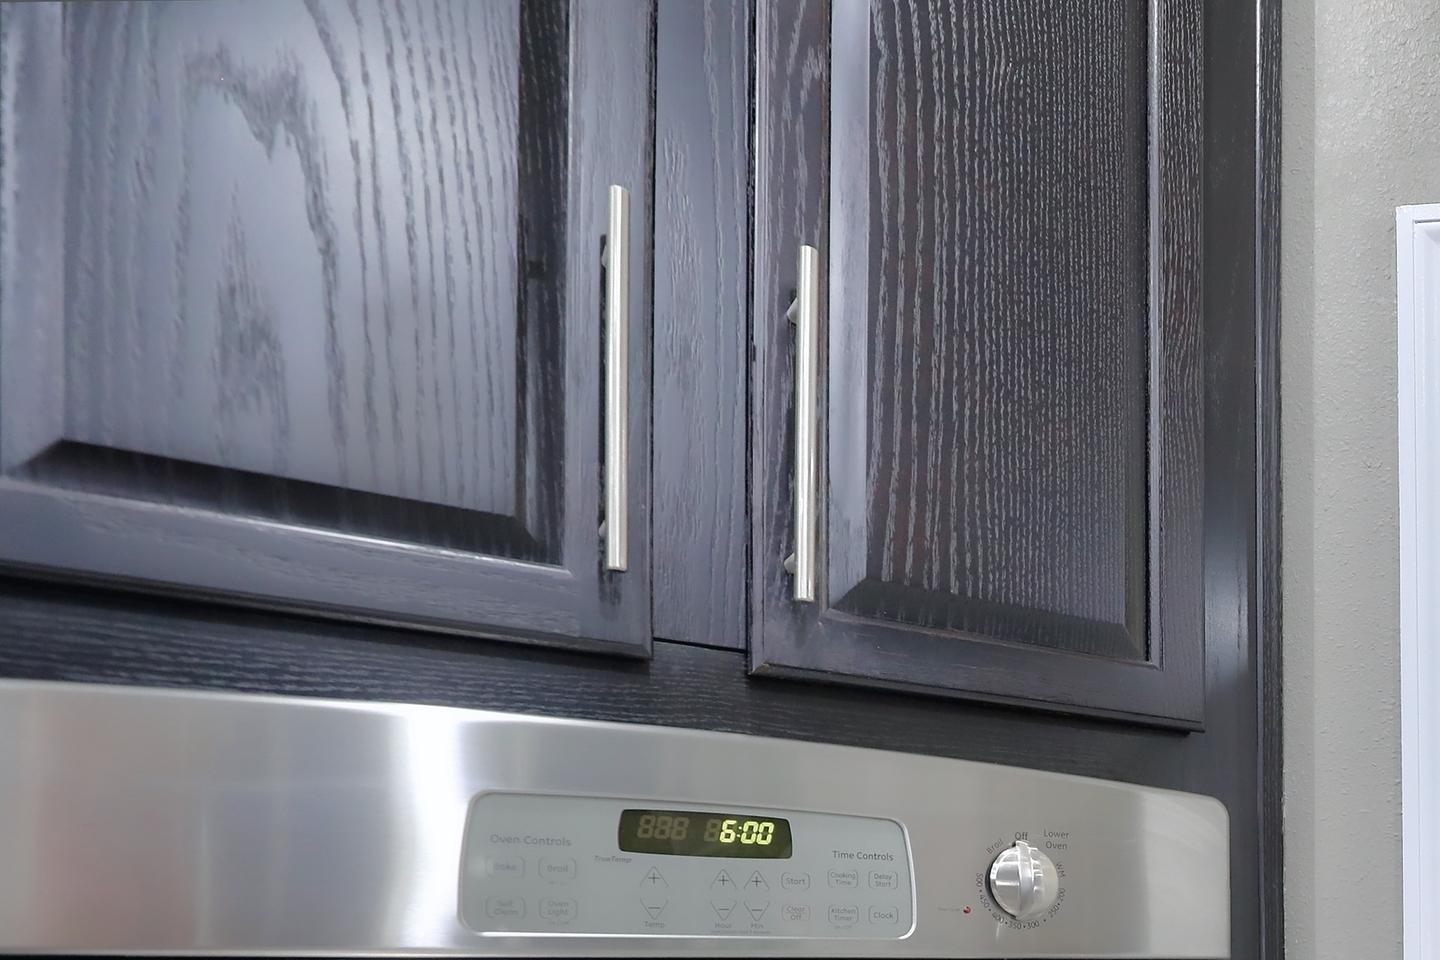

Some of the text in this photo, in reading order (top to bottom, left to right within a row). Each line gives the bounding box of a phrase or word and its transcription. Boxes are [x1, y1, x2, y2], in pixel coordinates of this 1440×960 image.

[719, 819, 775, 846] 6:00
[1015, 831, 1029, 841] Off
[1044, 829, 1070, 839] Lower
[489, 833, 573, 847] Oven Controls
[1045, 840, 1068, 850] Oven
[832, 850, 895, 861] Time Controls
[785, 877, 806, 885] Start
[873, 911, 894, 919] Clock
[1007, 920, 1022, 930] 350
[1026, 920, 1041, 930] 300
